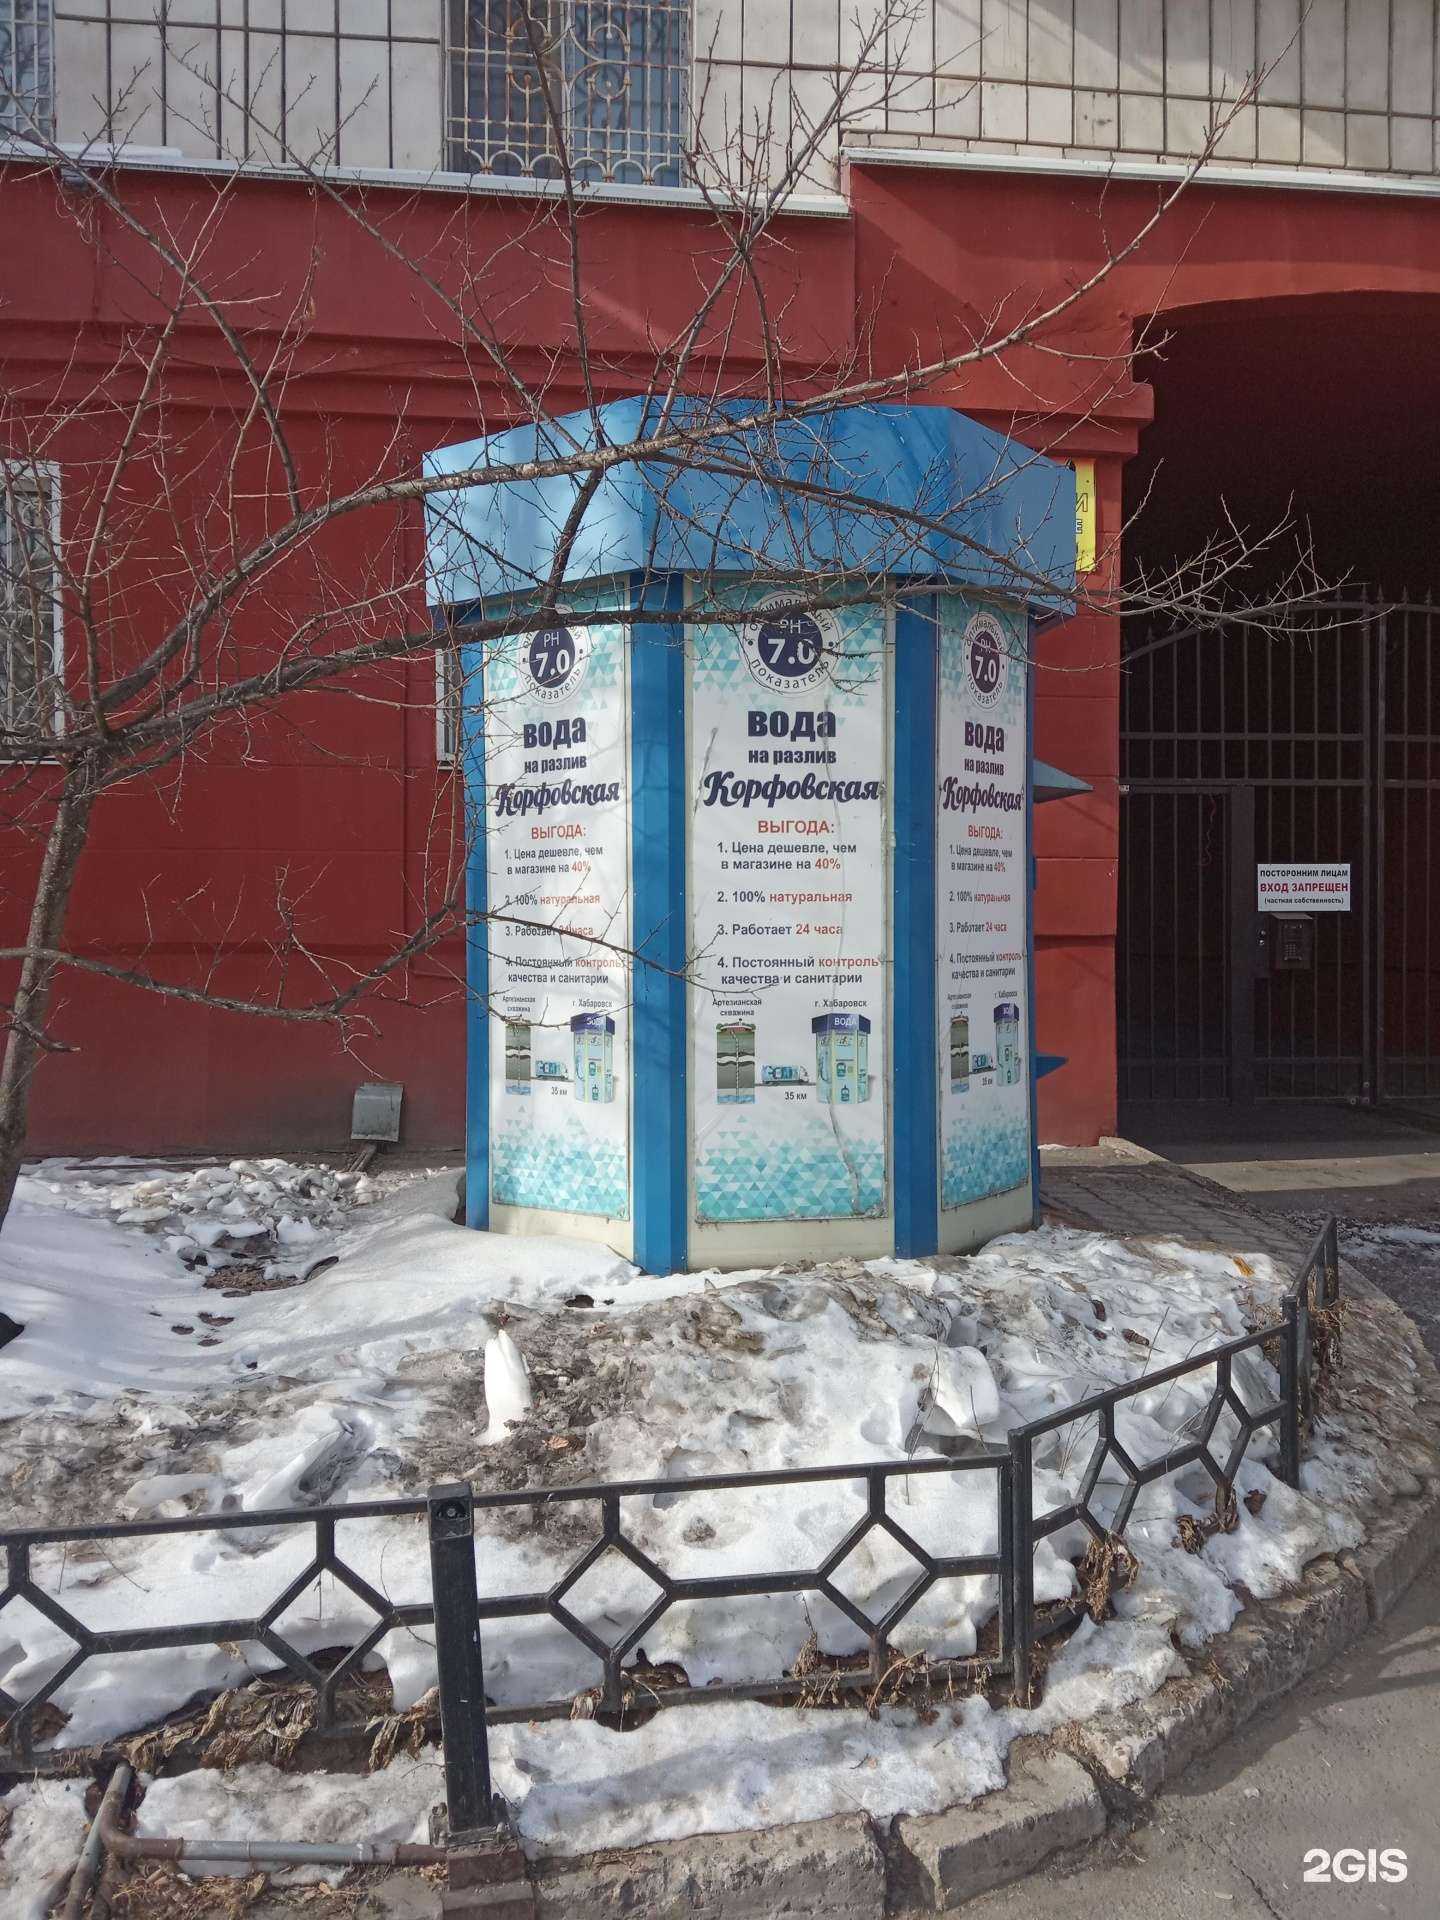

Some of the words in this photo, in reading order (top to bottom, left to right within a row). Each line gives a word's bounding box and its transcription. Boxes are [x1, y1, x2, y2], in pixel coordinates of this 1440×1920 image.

[767, 638, 815, 665] 7.0
[535, 649, 570, 678] 7.0
[975, 655, 997, 683] 7.0
[751, 658, 829, 689] показатель
[523, 716, 587, 750] вода
[747, 709, 836, 742] вода
[964, 720, 1005, 755] вода
[524, 760, 539, 773] на
[541, 755, 587, 774] разлив
[749, 750, 769, 764] на
[773, 749, 837, 766] разлив
[964, 758, 974, 772] на
[975, 760, 1004, 776] разлив
[703, 770, 880, 808] Корфовская
[943, 776, 1022, 814] Корфовская
[495, 778, 620, 817] Корфовская
[531, 823, 587, 840] ВЫГОДА:
[758, 820, 835, 836] ВЫГОДА:
[968, 824, 1003, 840] ВЫГОДА:
[505, 849, 512, 860] 1.
[514, 848, 536, 861] Цена
[538, 847, 582, 860] дешевле,
[585, 846, 603, 856] чем
[717, 842, 728, 853] 1.
[732, 842, 764, 855] Цена
[767, 843, 829, 855] дешевле,
[833, 844, 857, 853] чем
[1001, 850, 1013, 858] чем
[507, 866, 513, 875] в
[515, 864, 556, 875] магазине
[559, 863, 570, 873] на
[571, 860, 591, 873] 40%
[721, 861, 729, 869] в
[733, 860, 793, 870] магазине
[796, 860, 811, 869] на
[815, 858, 841, 870] 40%
[951, 862, 956, 871] в
[957, 863, 985, 872] магазине
[985, 863, 993, 872] на
[1260, 869, 1319, 877] ПОСТОРОННИМ
[1321, 869, 1348, 878] ЛИЦАМ
[1260, 883, 1289, 893] ВХОД
[1292, 883, 1348, 894] ЗАПРЕЩЕН
[515, 893, 538, 906] 100%
[540, 894, 600, 908] натуральная
[717, 891, 728, 902] 2.
[732, 890, 766, 903] 100%
[769, 892, 853, 905] натуральная
[956, 891, 973, 902] 100%
[505, 925, 513, 936] 3.
[717, 924, 728, 935] 3.
[732, 923, 792, 935] Работает
[795, 923, 810, 935] 24
[814, 924, 843, 935] часа
[956, 922, 985, 933] Работает
[985, 922, 993, 932] 24
[993, 923, 1007, 932] часа
[575, 958, 622, 970] контроль
[717, 957, 728, 968] 4.
[732, 956, 815, 968] Постоянный
[818, 957, 879, 969] контроль
[949, 953, 956, 964] 4.
[956, 952, 995, 964] Постоянный
[507, 973, 548, 984] качества
[550, 974, 556, 983] и
[558, 972, 609, 985] санитарии
[721, 975, 780, 985] качества
[783, 975, 791, 984] и
[795, 974, 863, 986] санитарии
[951, 969, 979, 980] качества
[980, 969, 985, 978] и
[985, 966, 1016, 978] санитарии
[713, 999, 762, 1008] Артезианская
[822, 1000, 868, 1009] Хабаровск
[784, 1091, 795, 1100] 35
[796, 1092, 807, 1100] км
